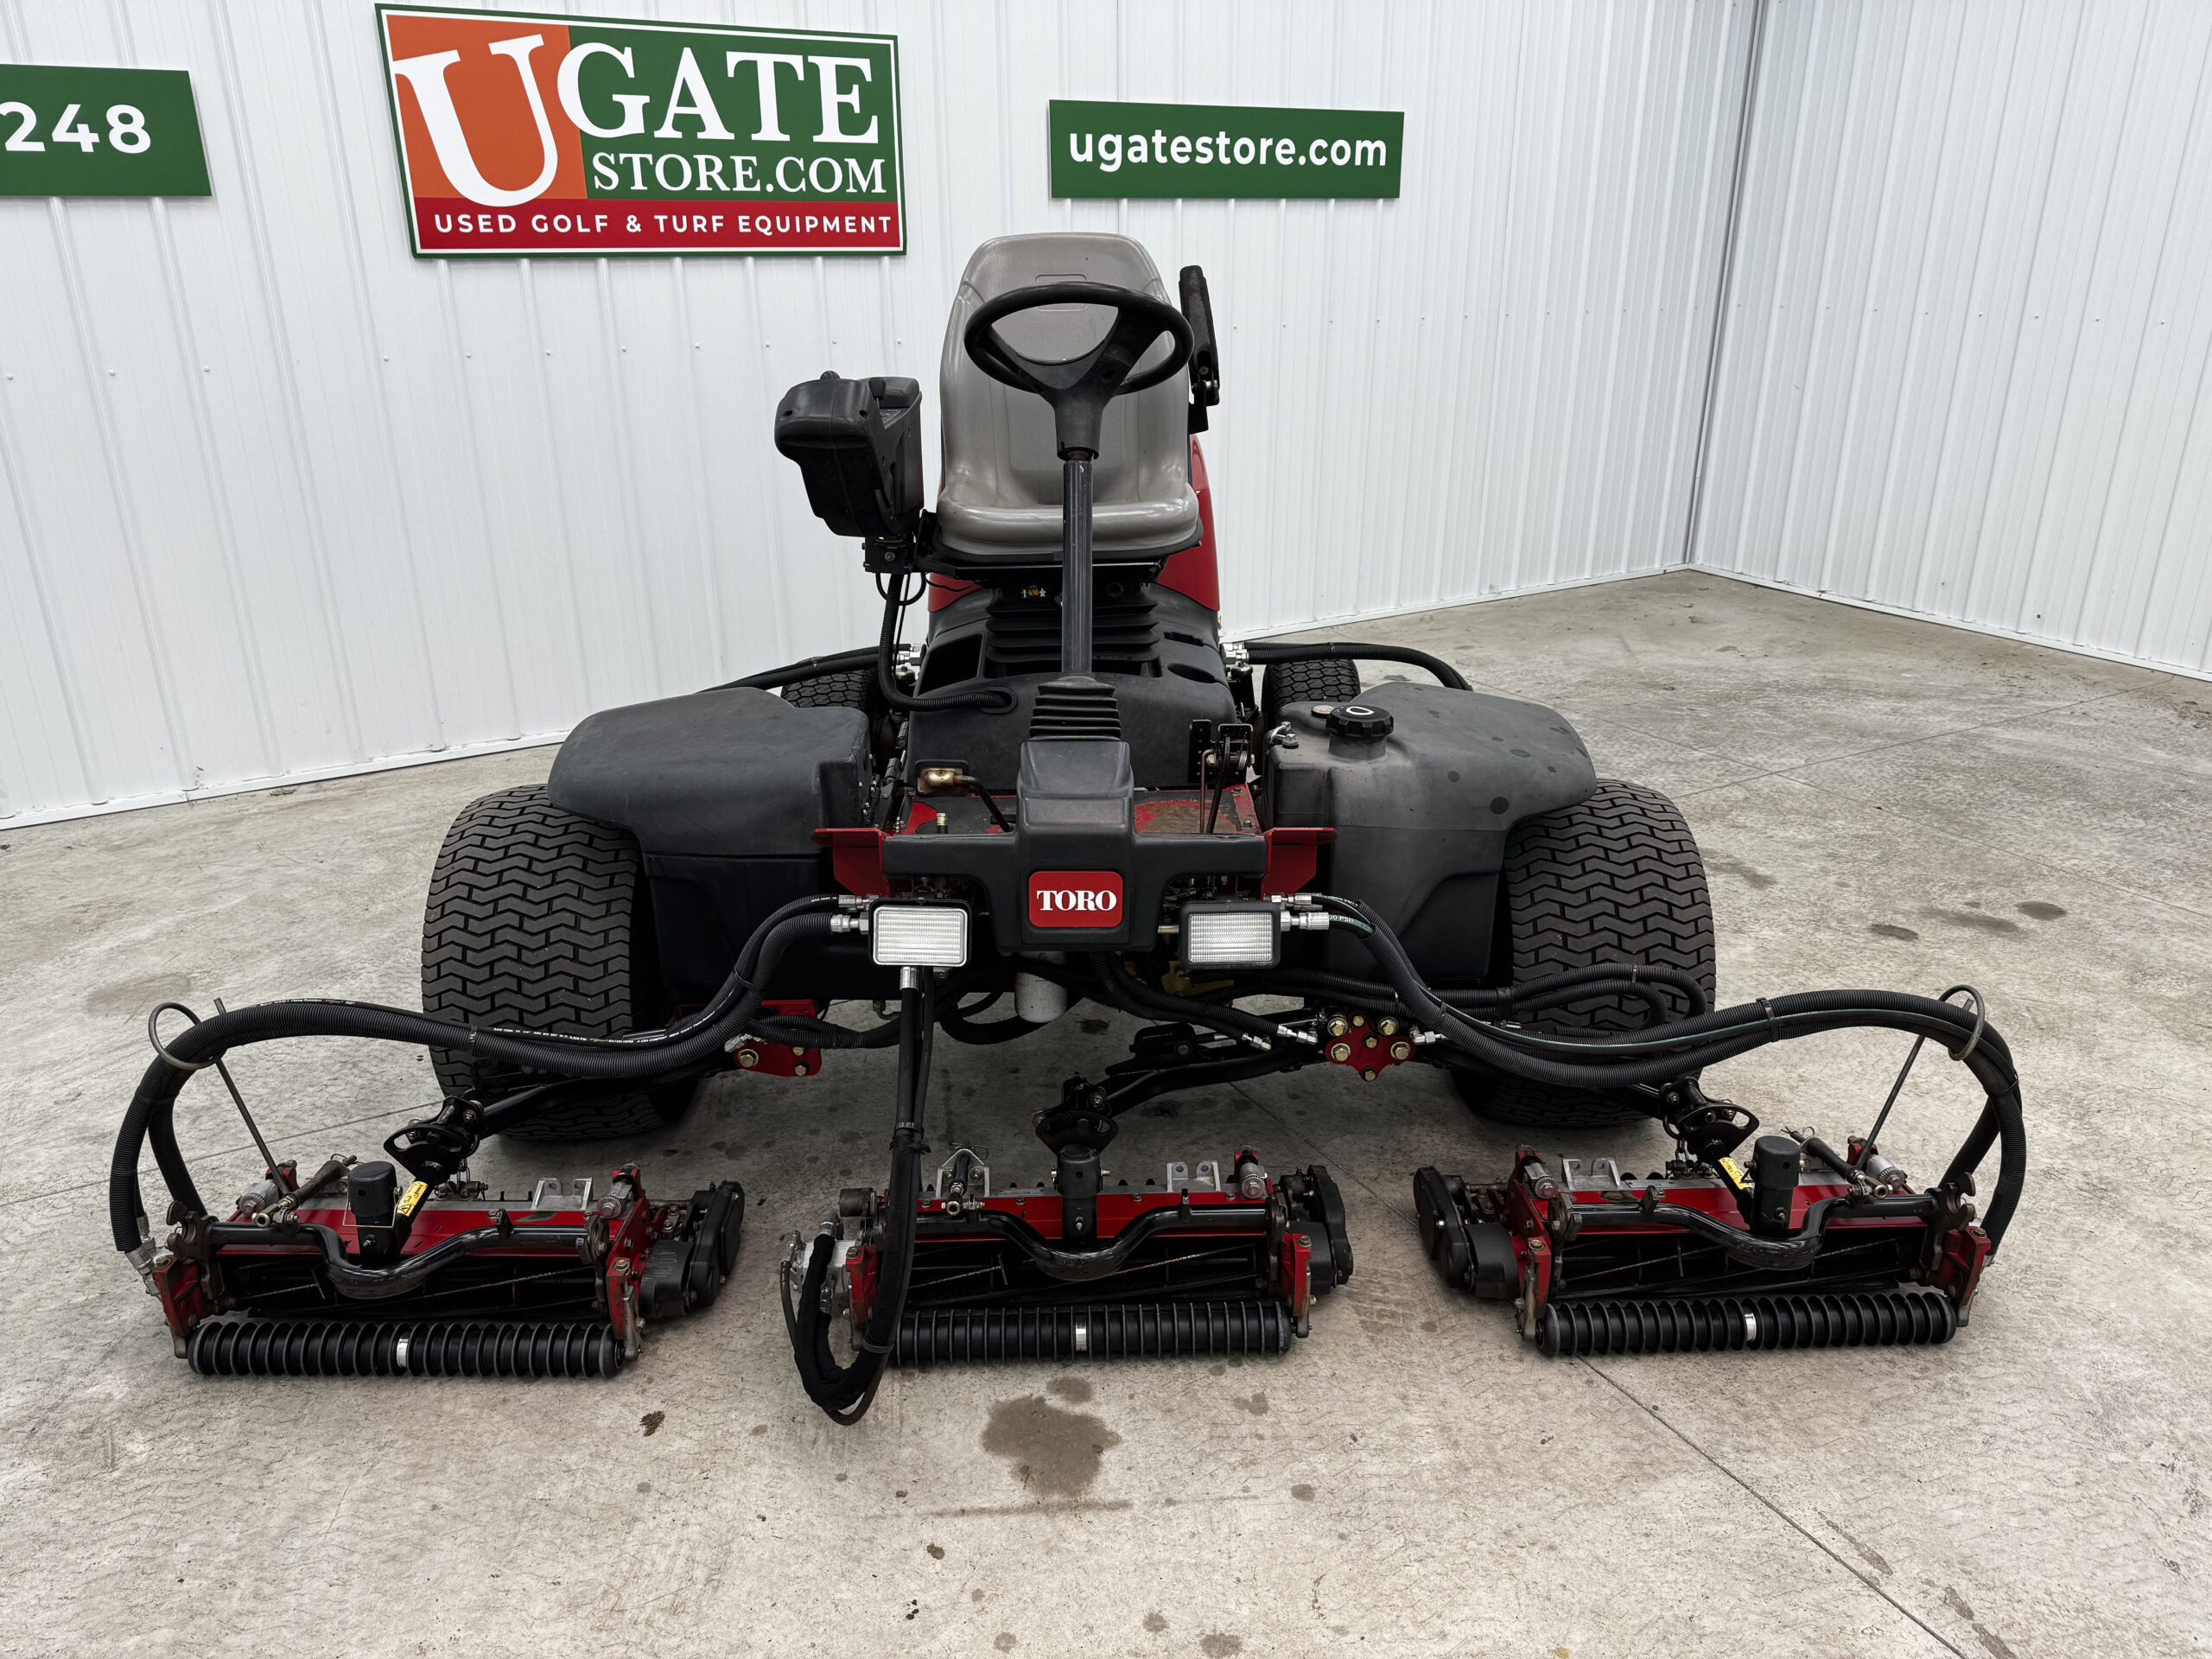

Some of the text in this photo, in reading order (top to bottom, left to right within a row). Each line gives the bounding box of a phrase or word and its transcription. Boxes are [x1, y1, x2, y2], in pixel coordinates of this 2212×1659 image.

[0, 101, 151, 154] 248
[592, 151, 887, 194] STORE.COM
[1069, 129, 1387, 173] ugatestore.com
[435, 213, 891, 236] USED GOLF & TURF EQUIPMENT
[1036, 890, 1117, 912] TORO
